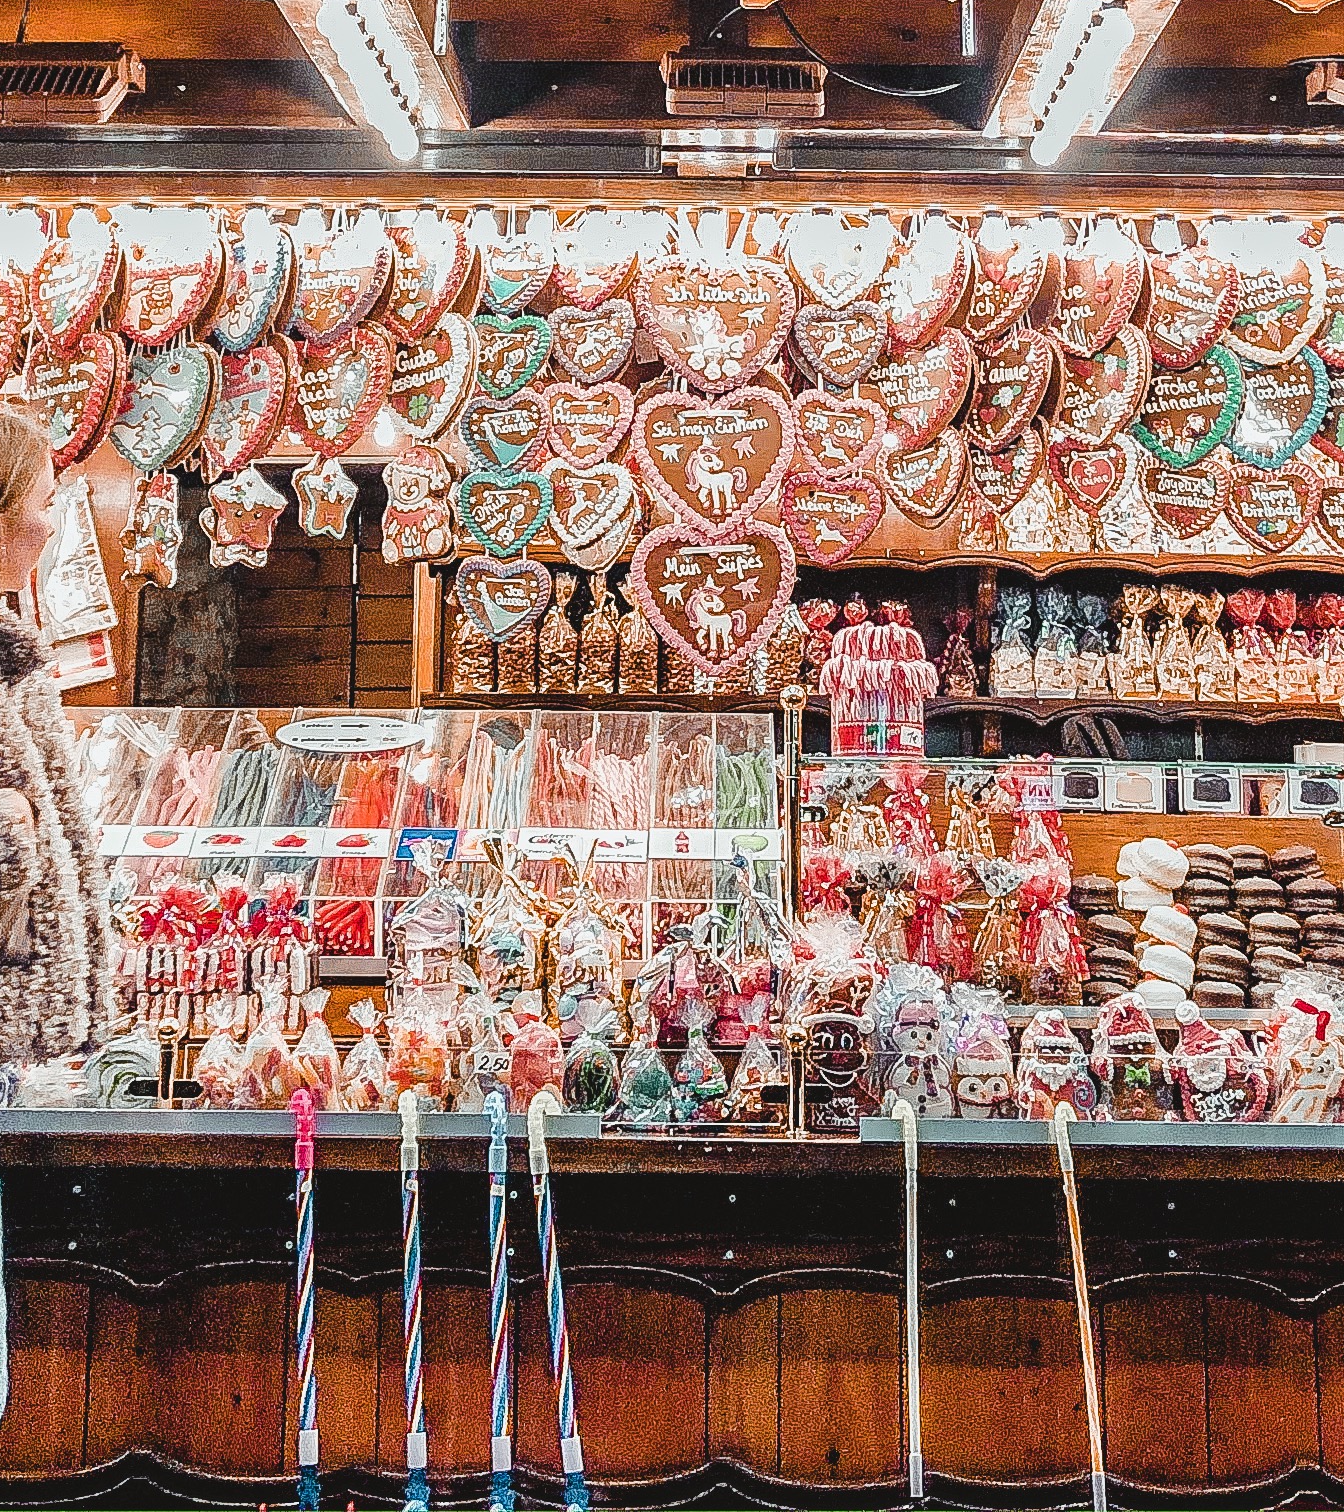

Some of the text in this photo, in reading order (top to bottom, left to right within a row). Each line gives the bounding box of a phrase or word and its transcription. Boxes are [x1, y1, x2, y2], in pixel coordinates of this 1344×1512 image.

[1058, 305, 1095, 329] you
[396, 349, 438, 373] Gute
[1152, 374, 1200, 396] Frohe
[298, 387, 337, 405] dich
[651, 418, 769, 437] Sei mein Einhorn
[663, 557, 701, 578] Mein
